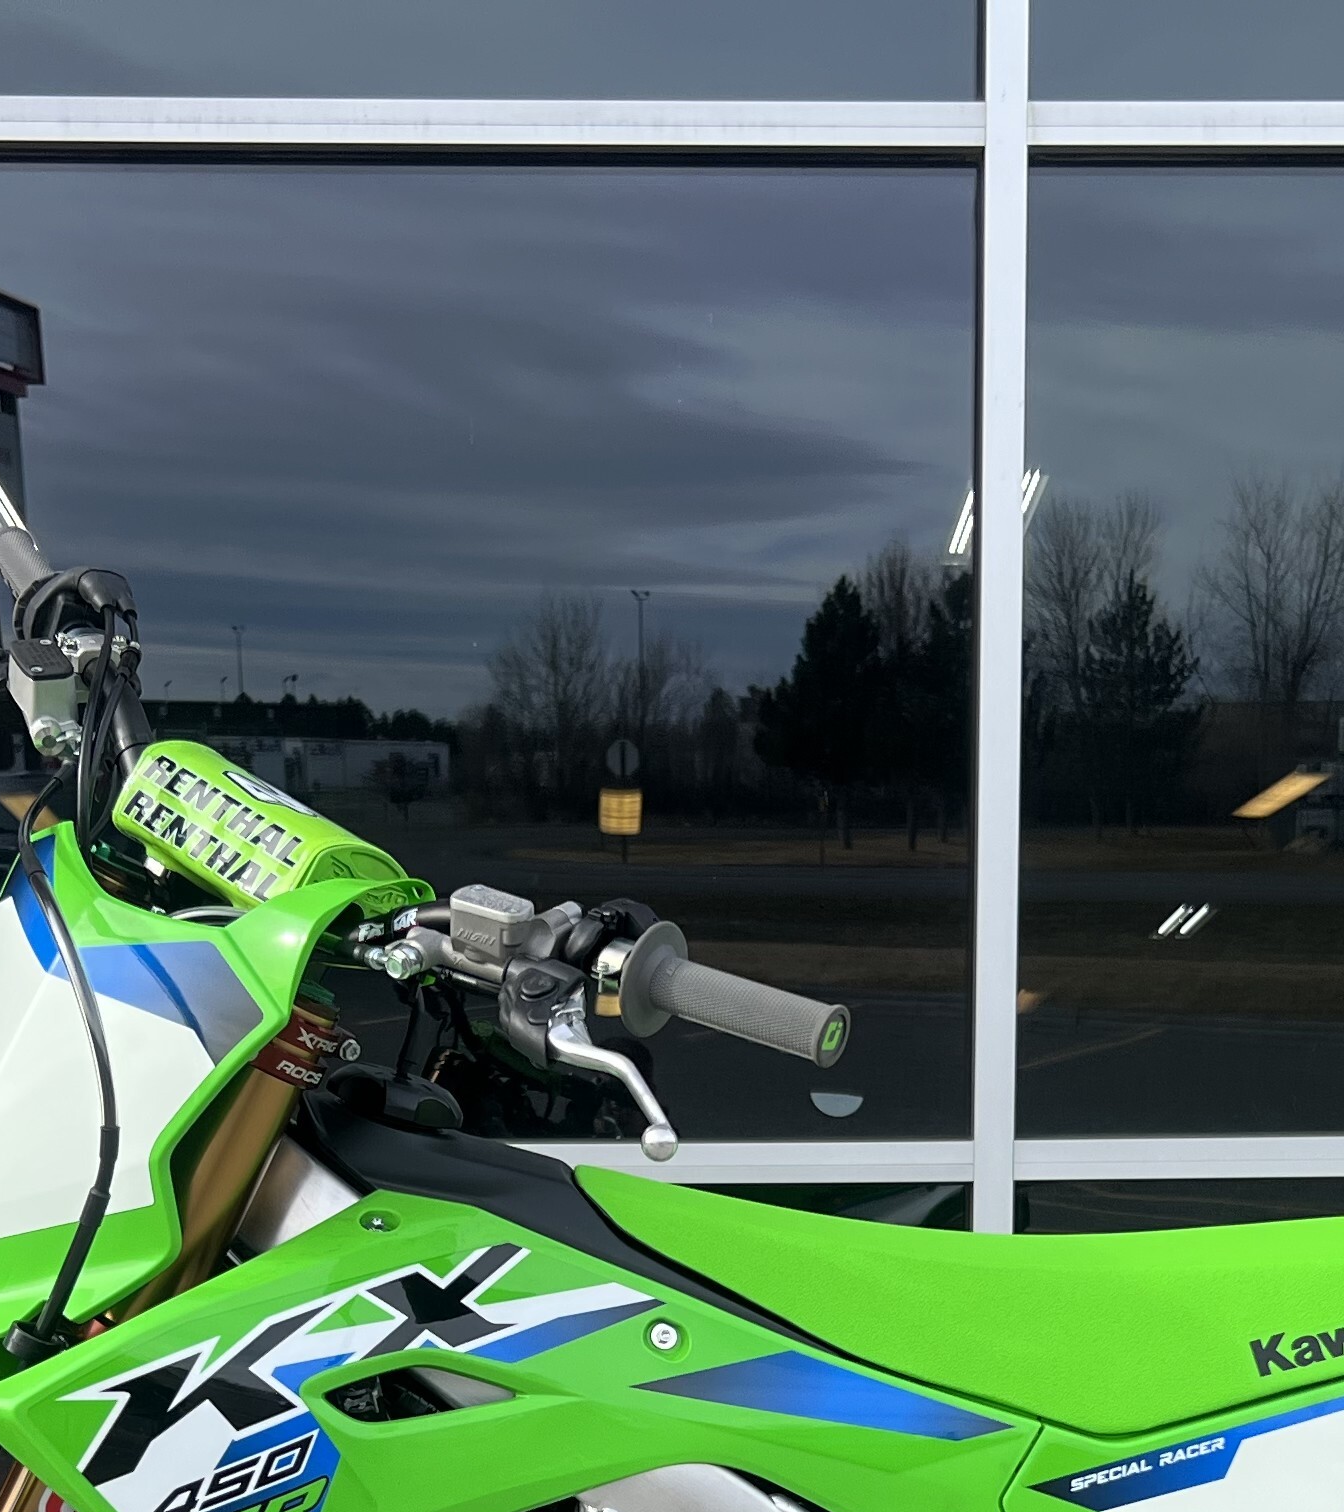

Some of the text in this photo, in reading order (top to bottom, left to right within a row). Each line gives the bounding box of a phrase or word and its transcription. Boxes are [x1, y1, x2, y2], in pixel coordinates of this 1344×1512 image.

[123, 789, 280, 903] RENTHAL
[142, 754, 306, 870] RENTHAL
[275, 1059, 324, 1085] ROCS
[296, 1026, 339, 1054] XTRIG
[80, 1242, 526, 1488] KX
[1069, 1436, 1226, 1493] SPECIAL RACER
